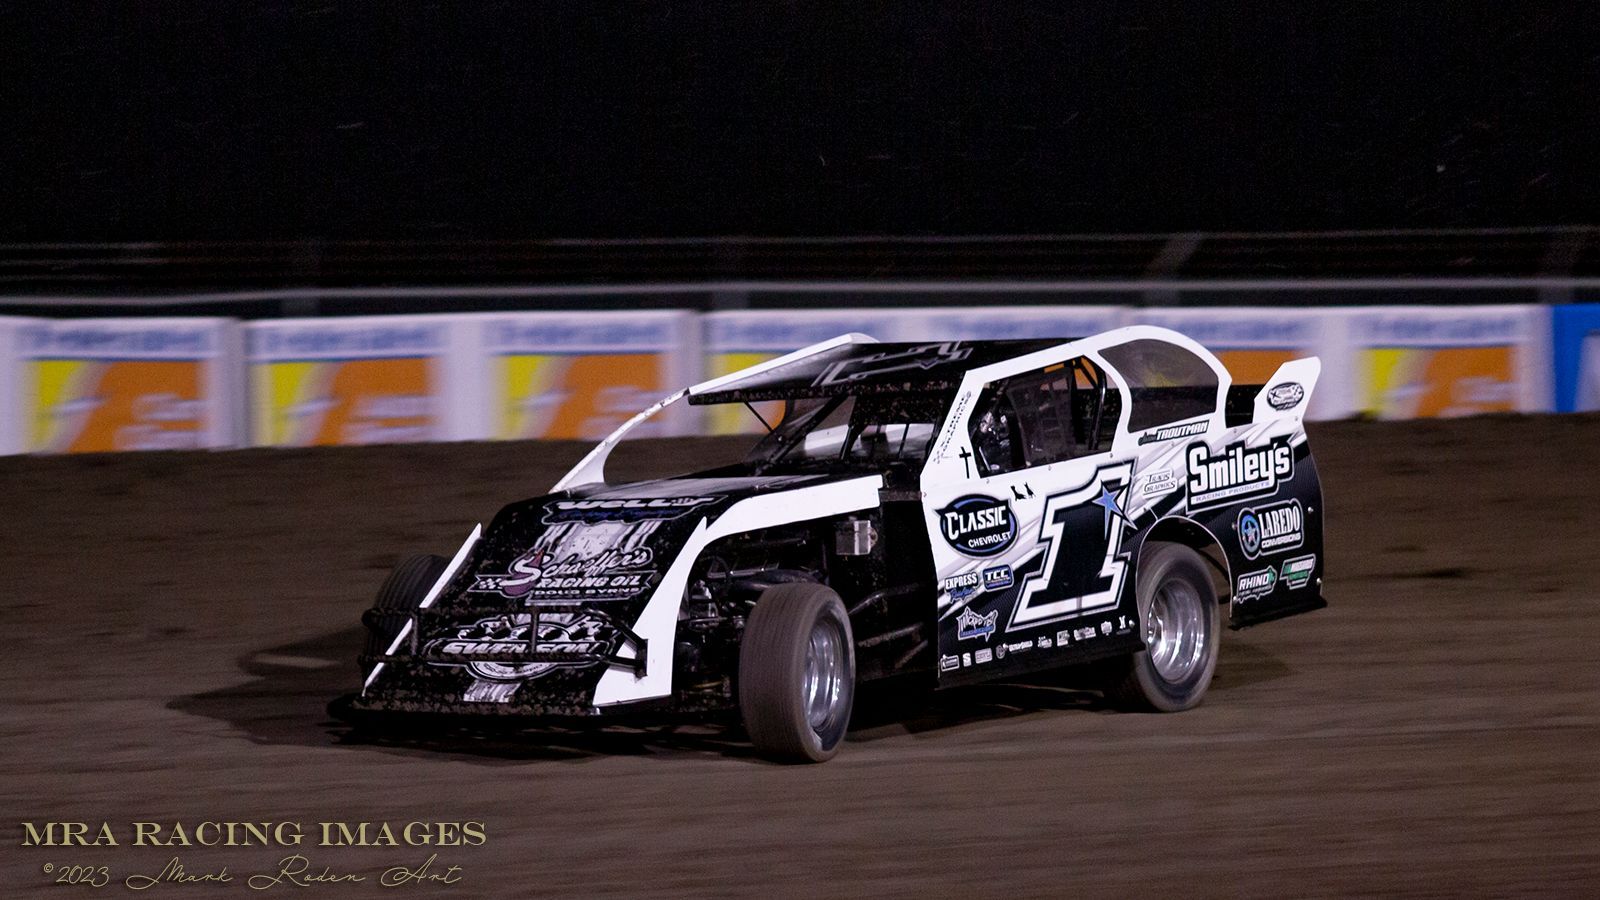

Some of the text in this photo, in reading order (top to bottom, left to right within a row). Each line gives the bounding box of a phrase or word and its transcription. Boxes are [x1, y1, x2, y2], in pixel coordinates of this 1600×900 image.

[1156, 421, 1208, 441] TROUTMAN
[1189, 442, 1290, 493] Smiley's
[1195, 481, 1271, 502] RACING PRODUCTS
[1257, 505, 1301, 539] LAREDO
[967, 531, 1012, 549] CHEVROLET
[1009, 460, 1135, 628] 1
[533, 574, 642, 588] RACING OIL
[945, 573, 978, 590] EXPRESS
[985, 568, 1009, 581] TCC
[1239, 573, 1269, 592] RHINO
